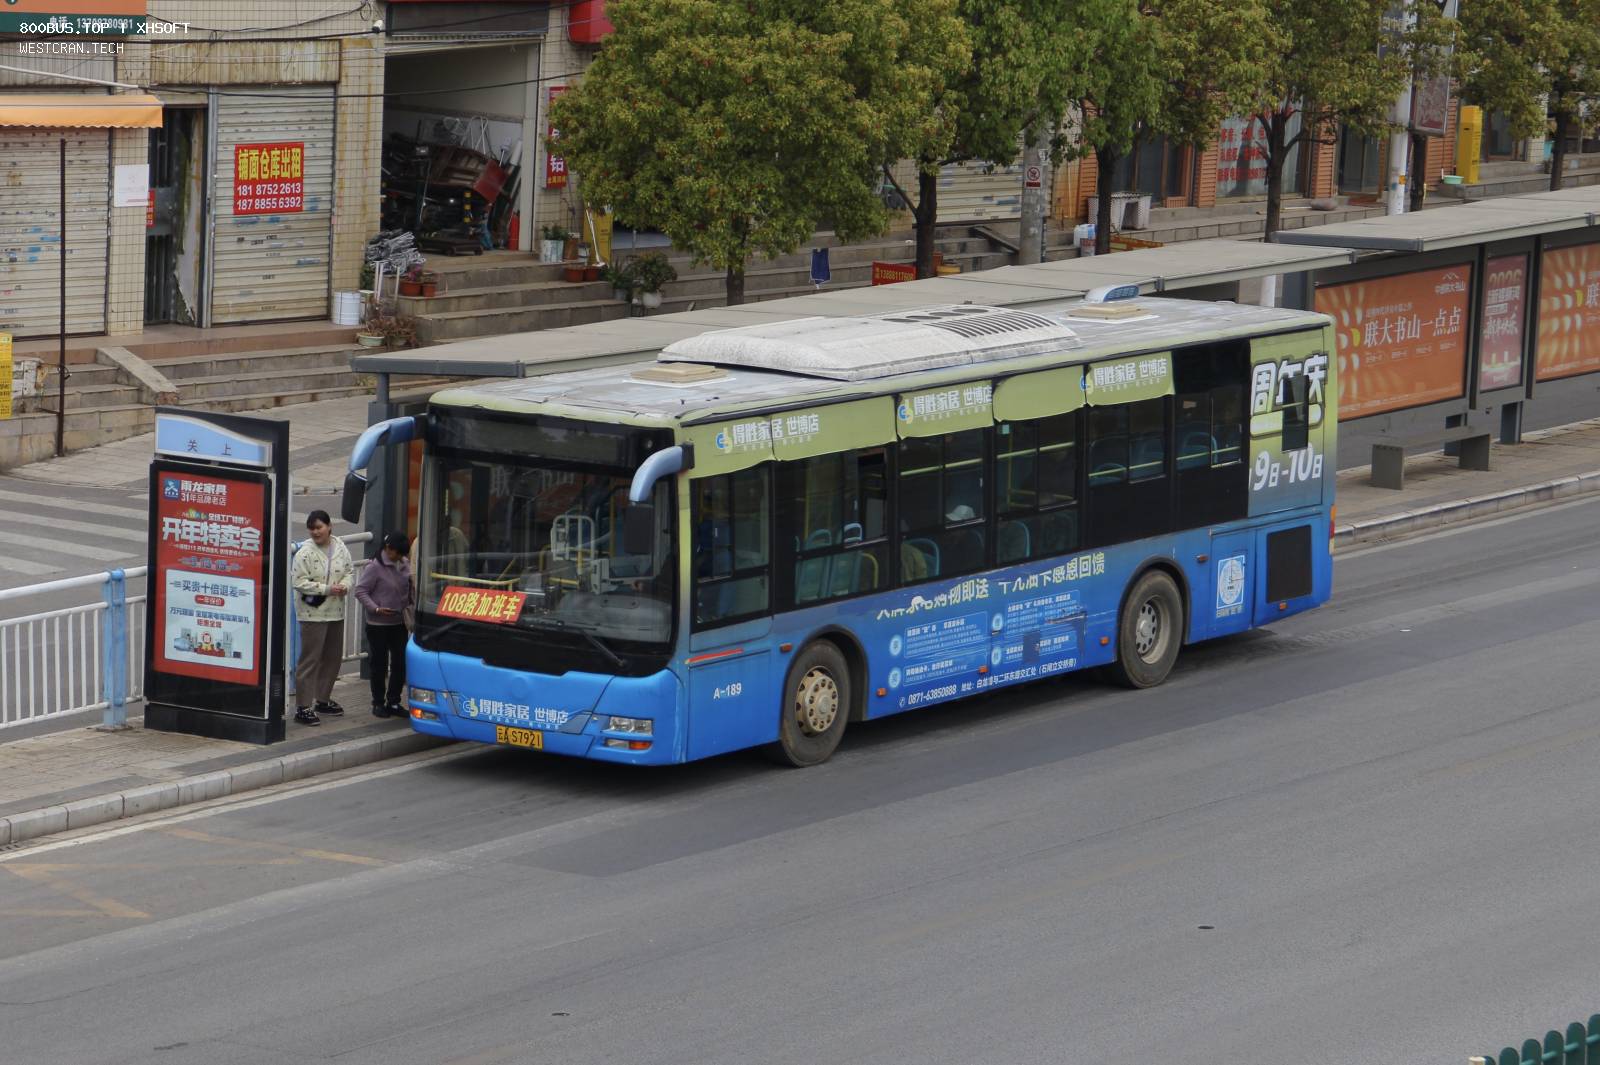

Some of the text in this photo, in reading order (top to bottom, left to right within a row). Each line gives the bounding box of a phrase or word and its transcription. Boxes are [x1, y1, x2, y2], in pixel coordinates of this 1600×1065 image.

[238, 147, 301, 180] 铺面仓库出租
[237, 183, 301, 196] 181 8752 2613
[237, 197, 301, 211] 187 8855 6392
[1363, 305, 1462, 348] 联大书山一点点
[1094, 363, 1136, 387] 得胜家居
[1138, 358, 1168, 378] 世博店
[913, 390, 960, 416] 得胜家居
[963, 385, 992, 406] 世博店
[733, 418, 783, 446] 得胜家居
[786, 413, 819, 436] 世博店
[162, 516, 261, 552] 开年特卖会
[441, 591, 521, 621] 108路加班车
[713, 682, 742, 700] A-189
[480, 698, 530, 720] 得胜家居
[534, 706, 569, 724] 世博店
